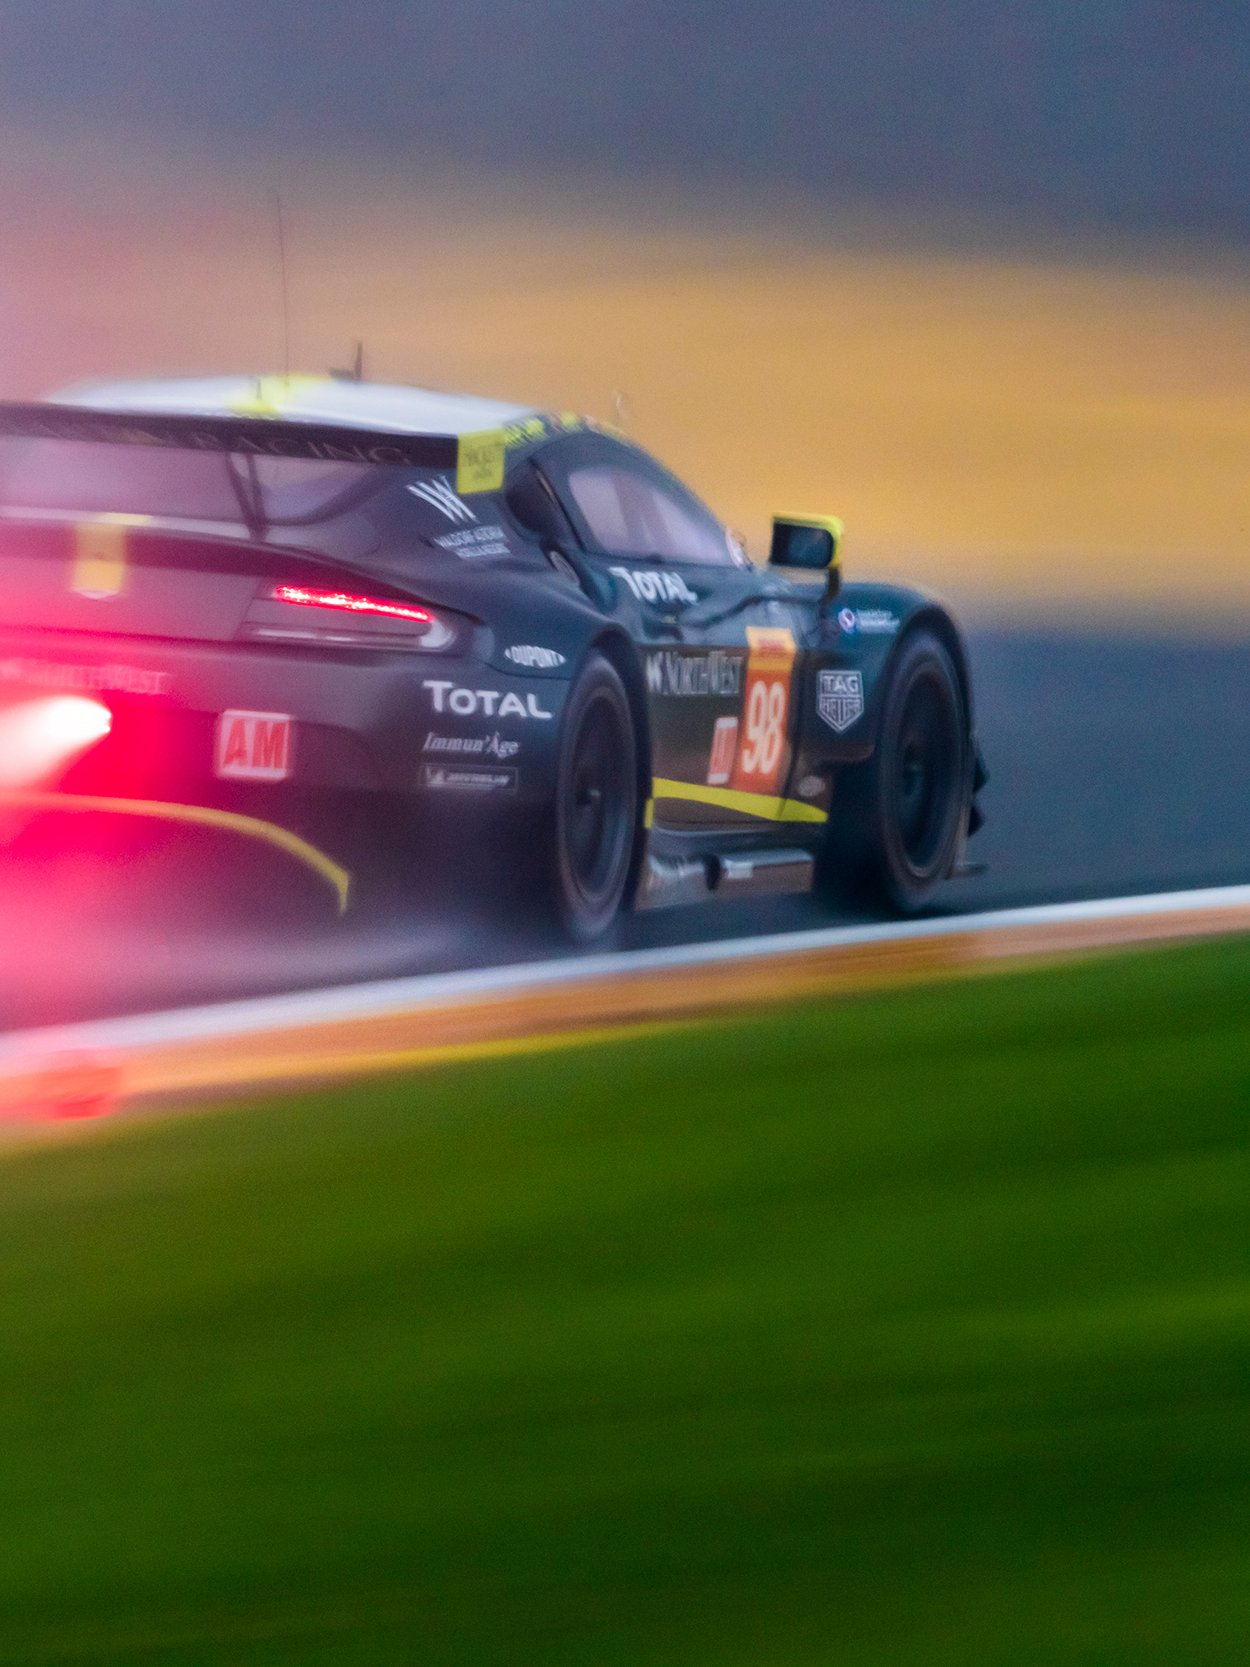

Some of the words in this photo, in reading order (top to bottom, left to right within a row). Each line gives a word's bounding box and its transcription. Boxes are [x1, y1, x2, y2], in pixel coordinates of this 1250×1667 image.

[608, 566, 698, 605] TOTAL
[423, 680, 552, 720] TOTAL
[822, 675, 859, 693] TAG
[223, 718, 290, 770] AM
[742, 680, 786, 775] 98
